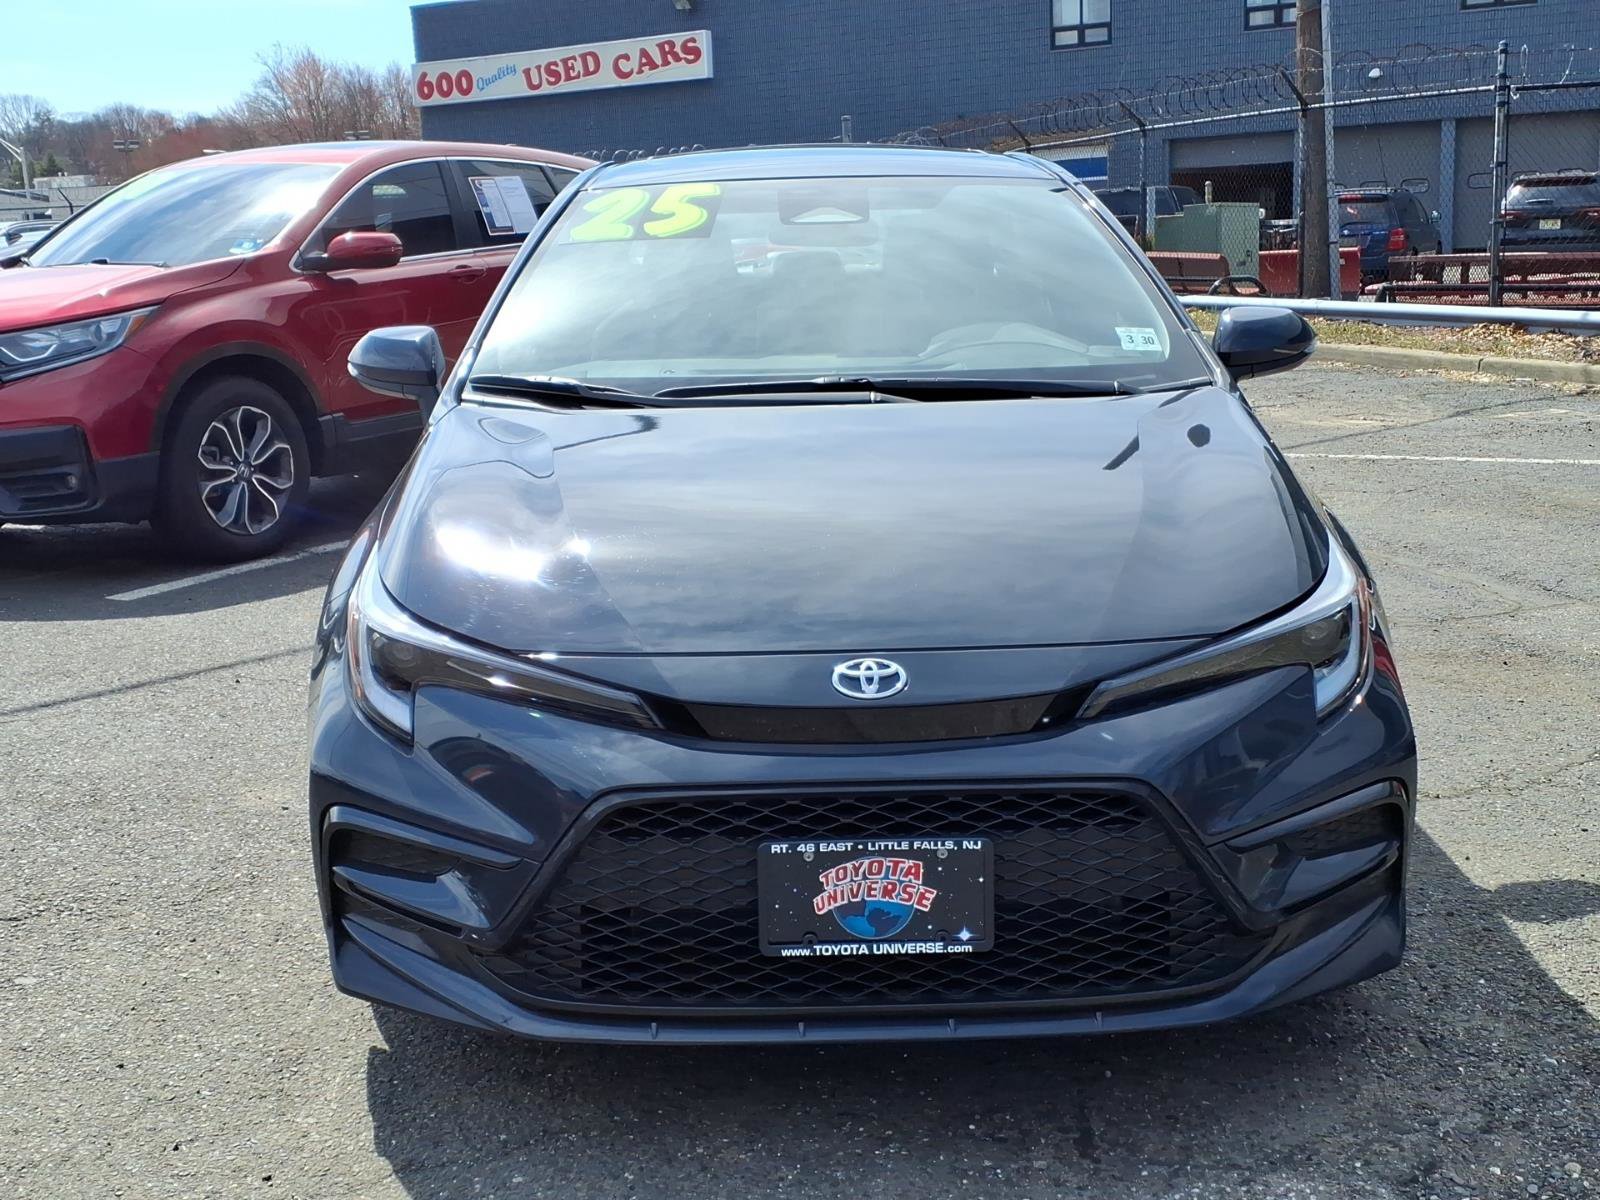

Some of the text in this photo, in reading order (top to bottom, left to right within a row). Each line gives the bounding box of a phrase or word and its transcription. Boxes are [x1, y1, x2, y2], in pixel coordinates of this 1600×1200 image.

[416, 36, 703, 101] 600 Quality USED CARS
[570, 183, 721, 243] 25
[770, 840, 982, 854] RT. 46 EAST LITTLE FALLS, NJ
[819, 857, 923, 890] TOYOTA
[813, 879, 937, 915] UNIVERSE
[781, 943, 973, 957] www.TOYOTA UNIVERSE.com
